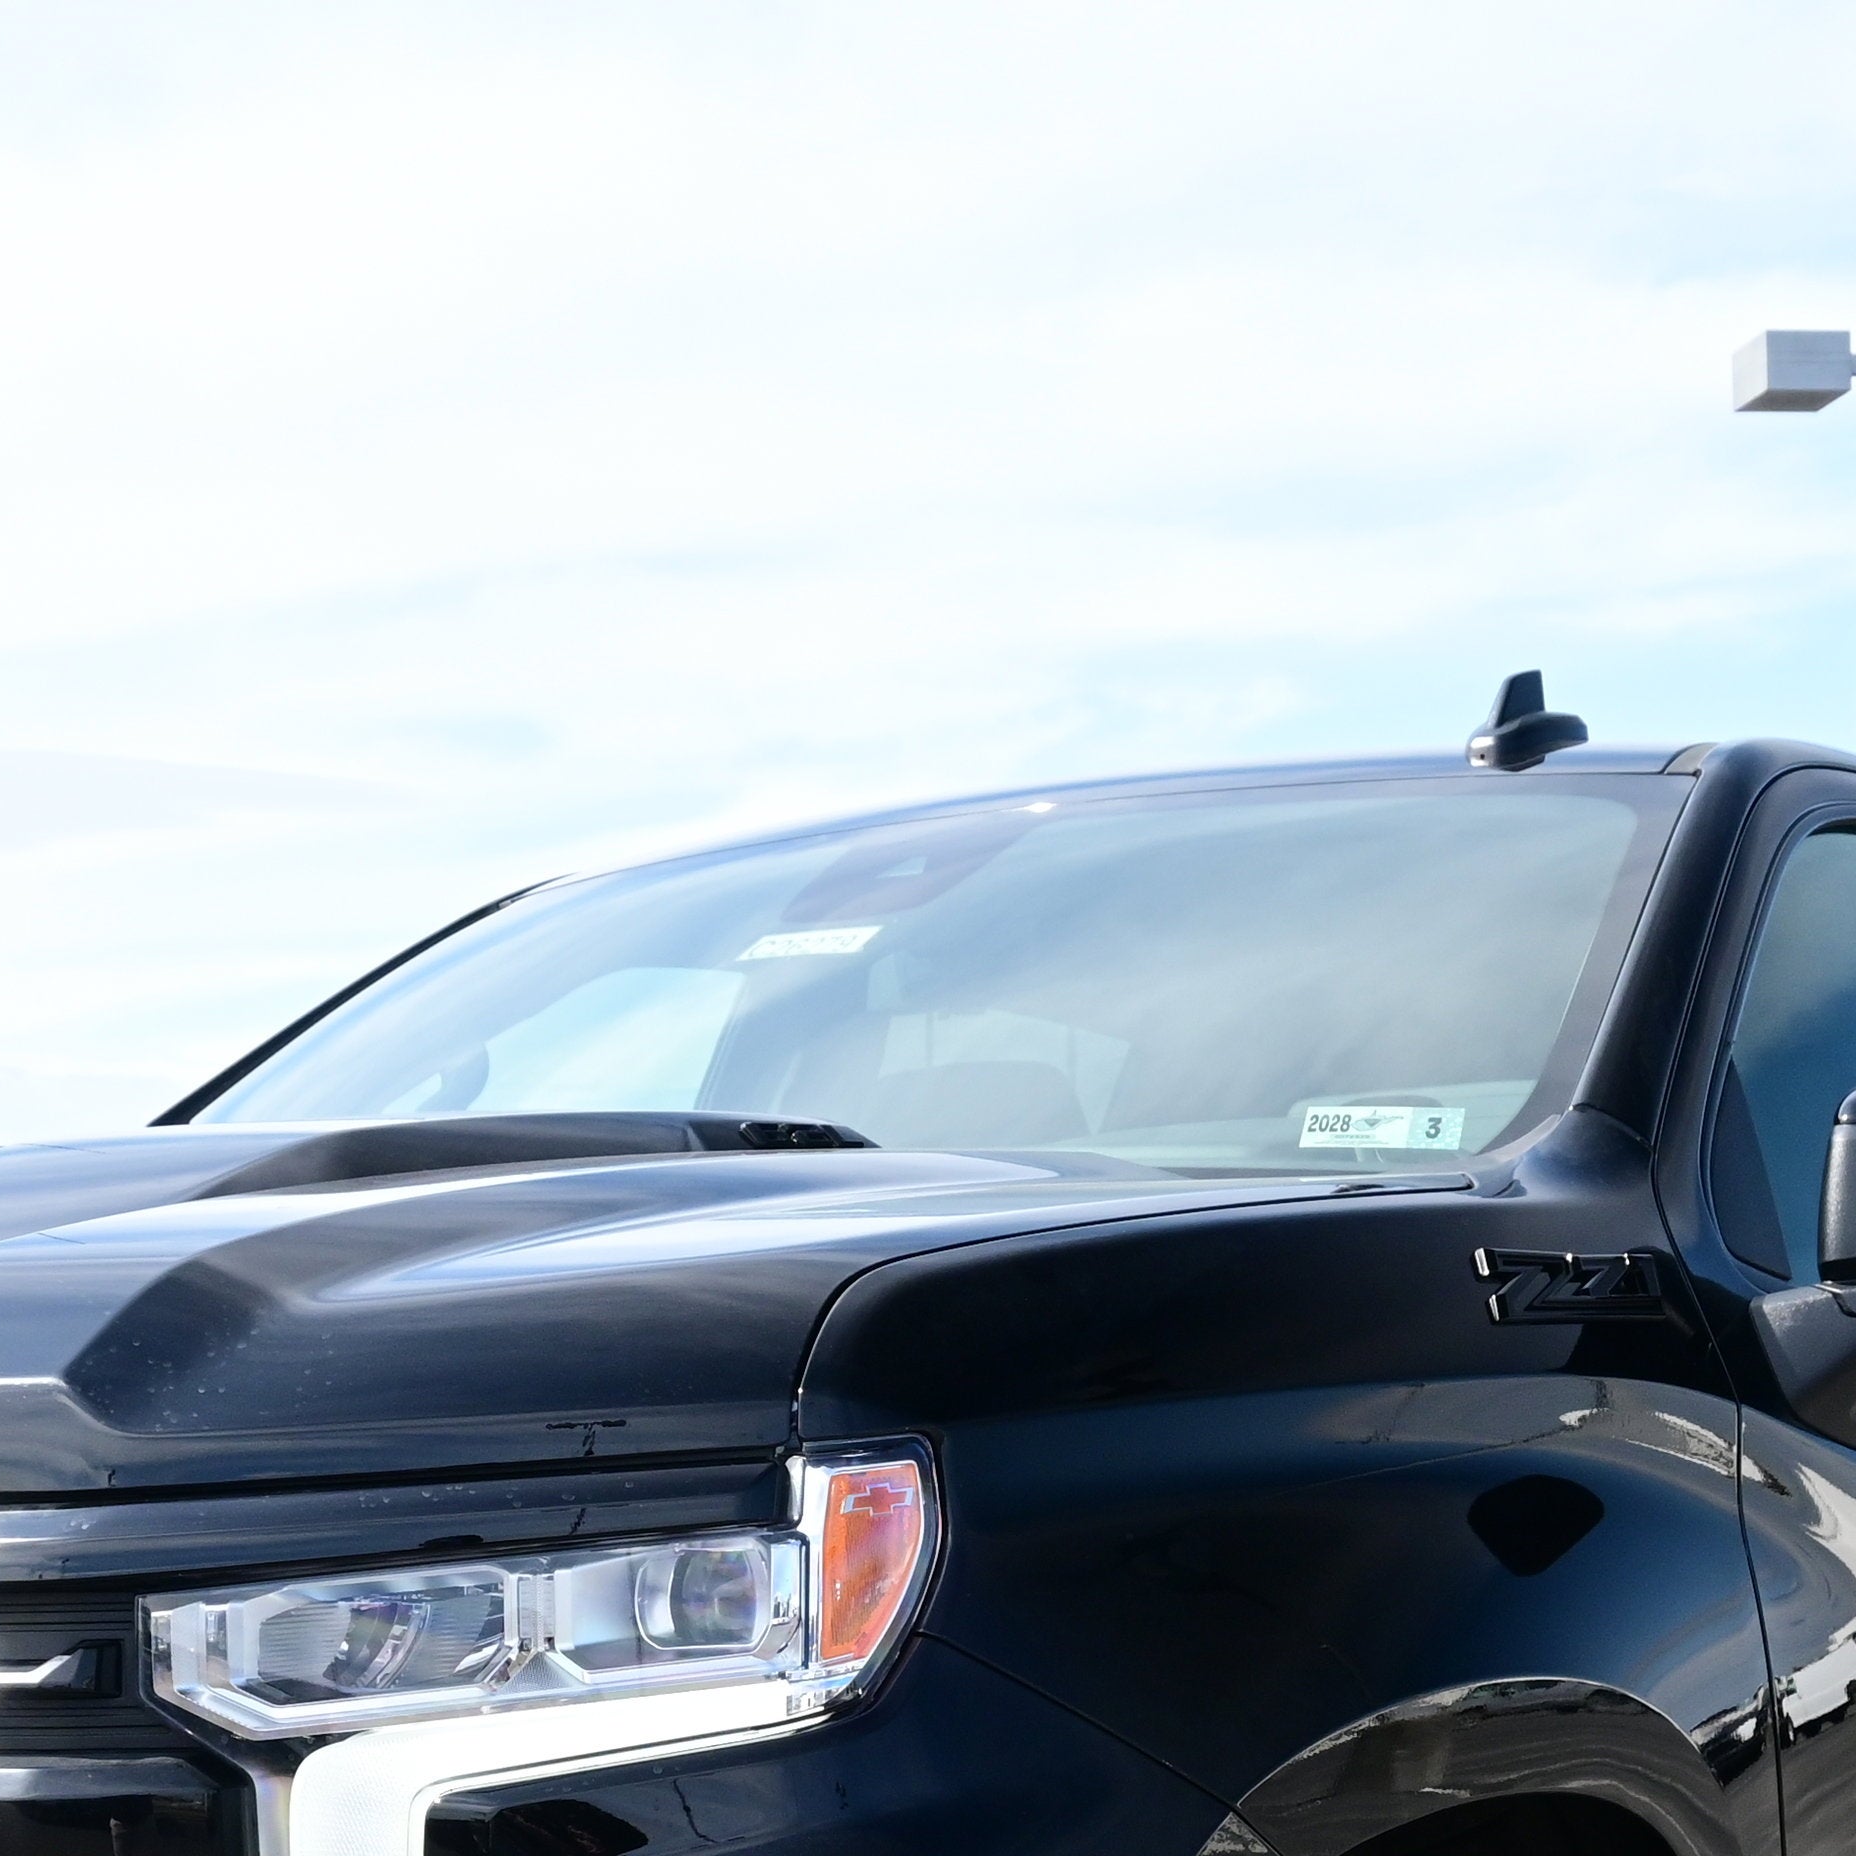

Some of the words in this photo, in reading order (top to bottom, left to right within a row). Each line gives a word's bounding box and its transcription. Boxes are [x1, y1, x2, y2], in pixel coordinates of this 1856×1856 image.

[1307, 1113, 1353, 1133] 2028
[1424, 1116, 1443, 1140] 3
[1473, 1247, 1666, 1324] Z71
